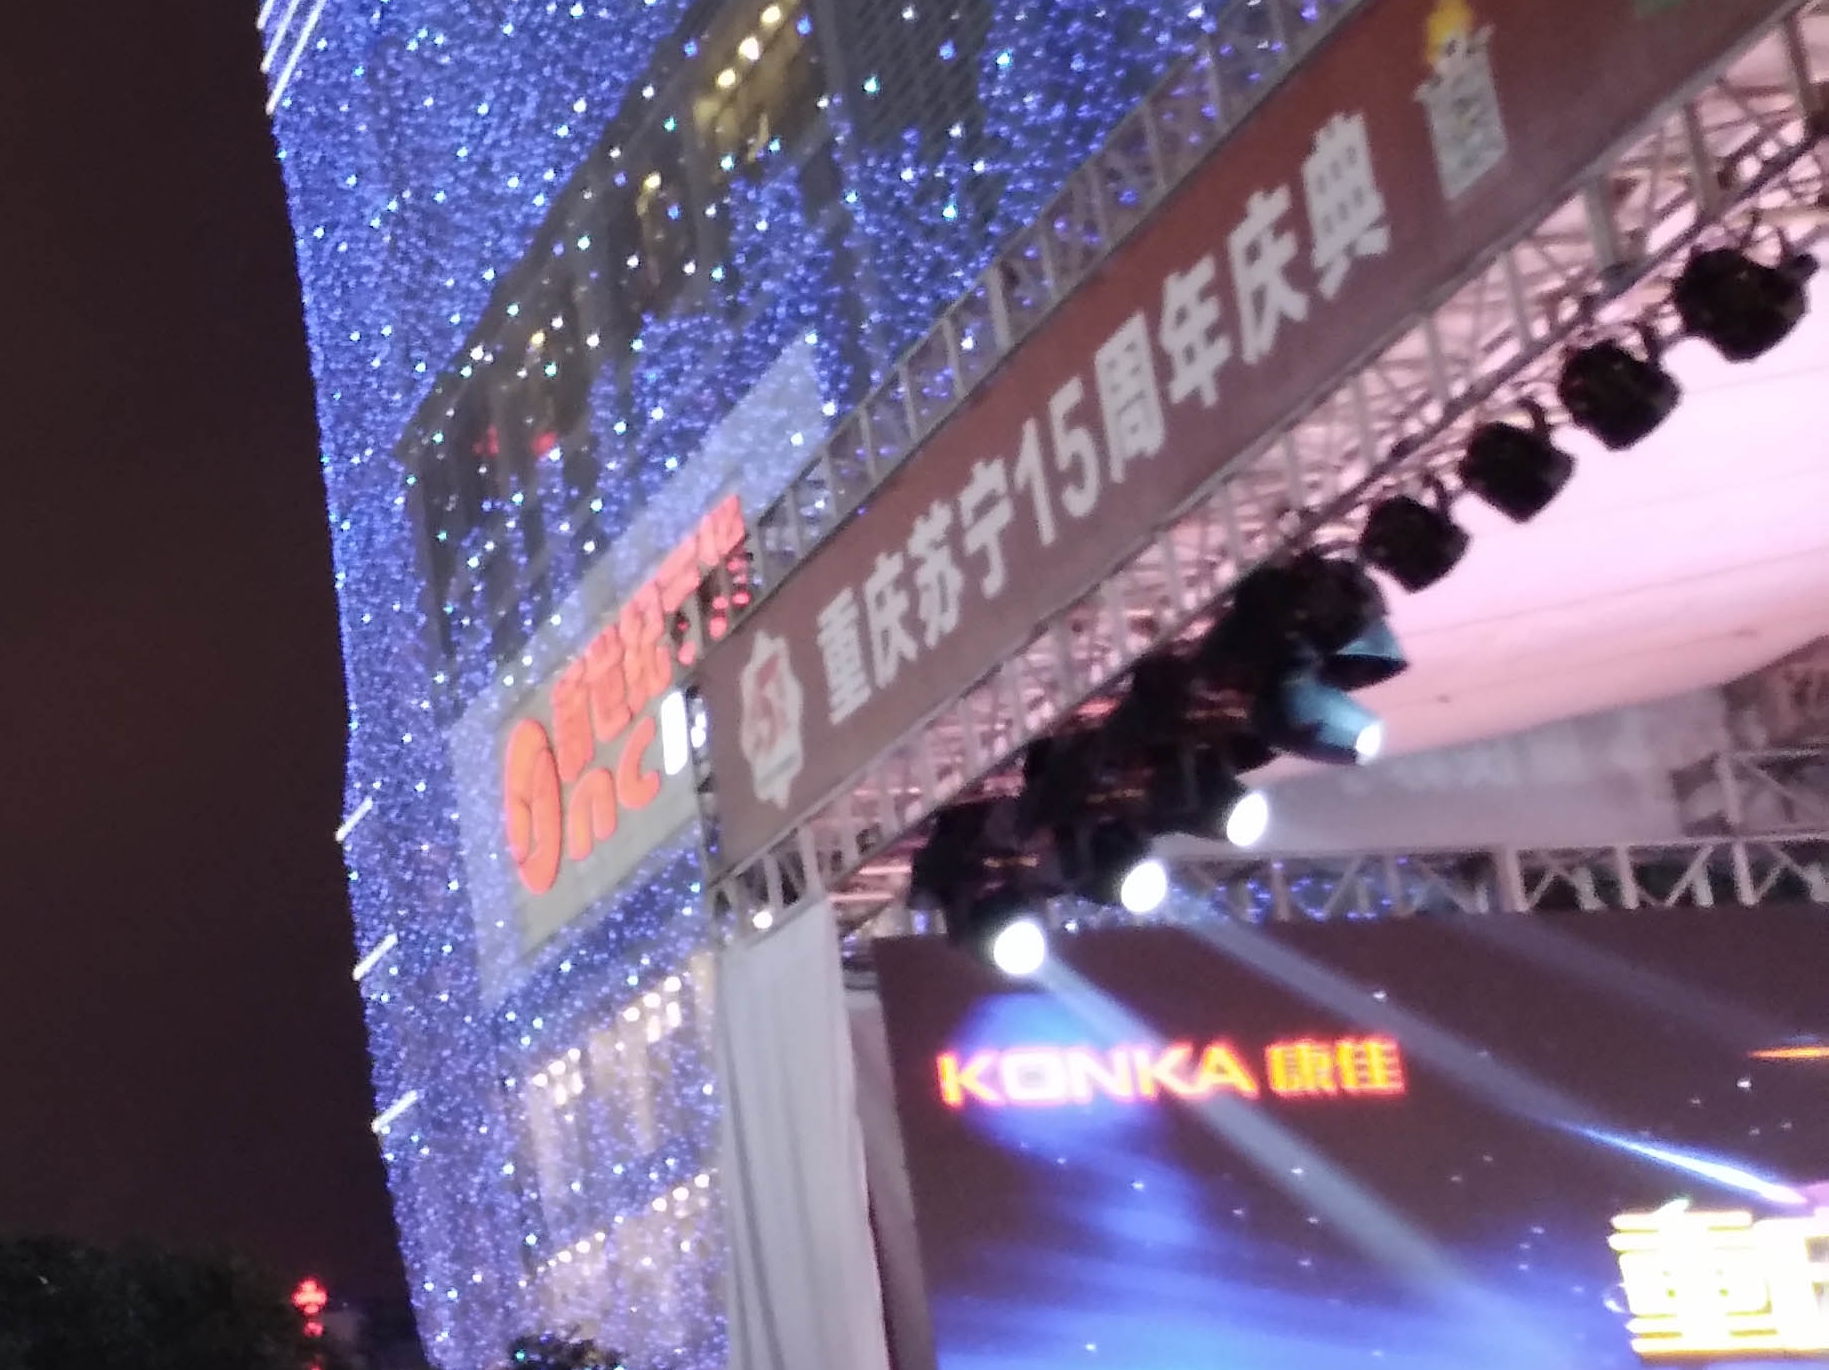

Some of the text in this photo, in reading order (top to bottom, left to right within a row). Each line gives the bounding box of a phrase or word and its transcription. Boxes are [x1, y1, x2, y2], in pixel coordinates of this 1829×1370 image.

[815, 113, 1391, 726] 重庆苏宁15周年庆典
[938, 1041, 1259, 1108] KONKA
